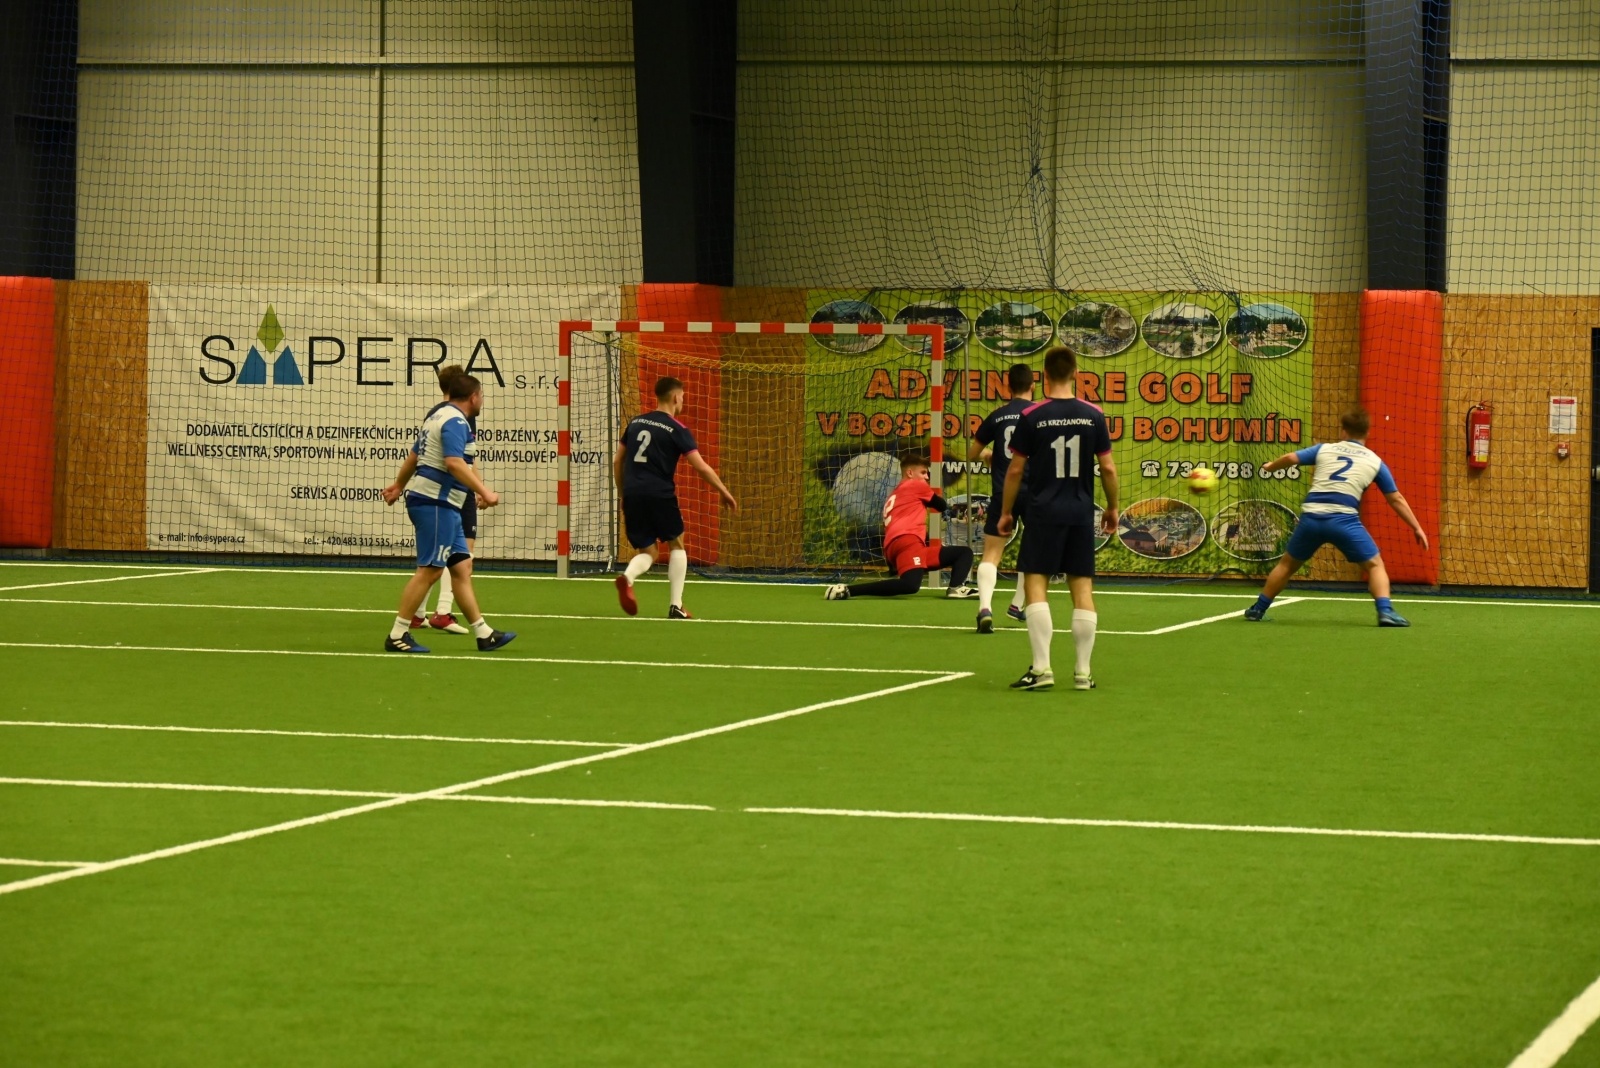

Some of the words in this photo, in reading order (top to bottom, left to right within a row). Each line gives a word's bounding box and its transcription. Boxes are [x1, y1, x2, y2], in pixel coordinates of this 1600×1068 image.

[1138, 371, 1253, 405] GOLF
[187, 423, 250, 437] DODAVATEL
[252, 422, 303, 438] ČISTÍCÍCH
[306, 426, 313, 438] A
[317, 424, 402, 440] DEZINFEKČNÍCH
[477, 429, 493, 442] RO
[495, 427, 541, 444] BAZÉNY,
[544, 430, 583, 445] SANY,
[816, 411, 841, 436] V
[1133, 411, 1302, 444] BOHUMÍN
[168, 443, 223, 457] WELLNESS
[225, 445, 270, 459] CENTRA,
[273, 444, 335, 459] SPORTOVNÍ
[338, 447, 367, 461] HALY,
[474, 446, 547, 463] PRŮMYSLOVÉ
[550, 451, 603, 464] PVOZY
[633, 429, 652, 463] 2
[1050, 434, 1081, 479] 11
[1213, 461, 1253, 480] 788
[1328, 455, 1354, 482] 2
[290, 487, 327, 500] SERVIS
[329, 488, 337, 500] A
[340, 488, 386, 501] ODBOR
[159, 531, 187, 543] e-mail:
[188, 533, 246, 545] info@sypera.cz
[359, 538, 373, 547] 312
[436, 544, 452, 563] 16
